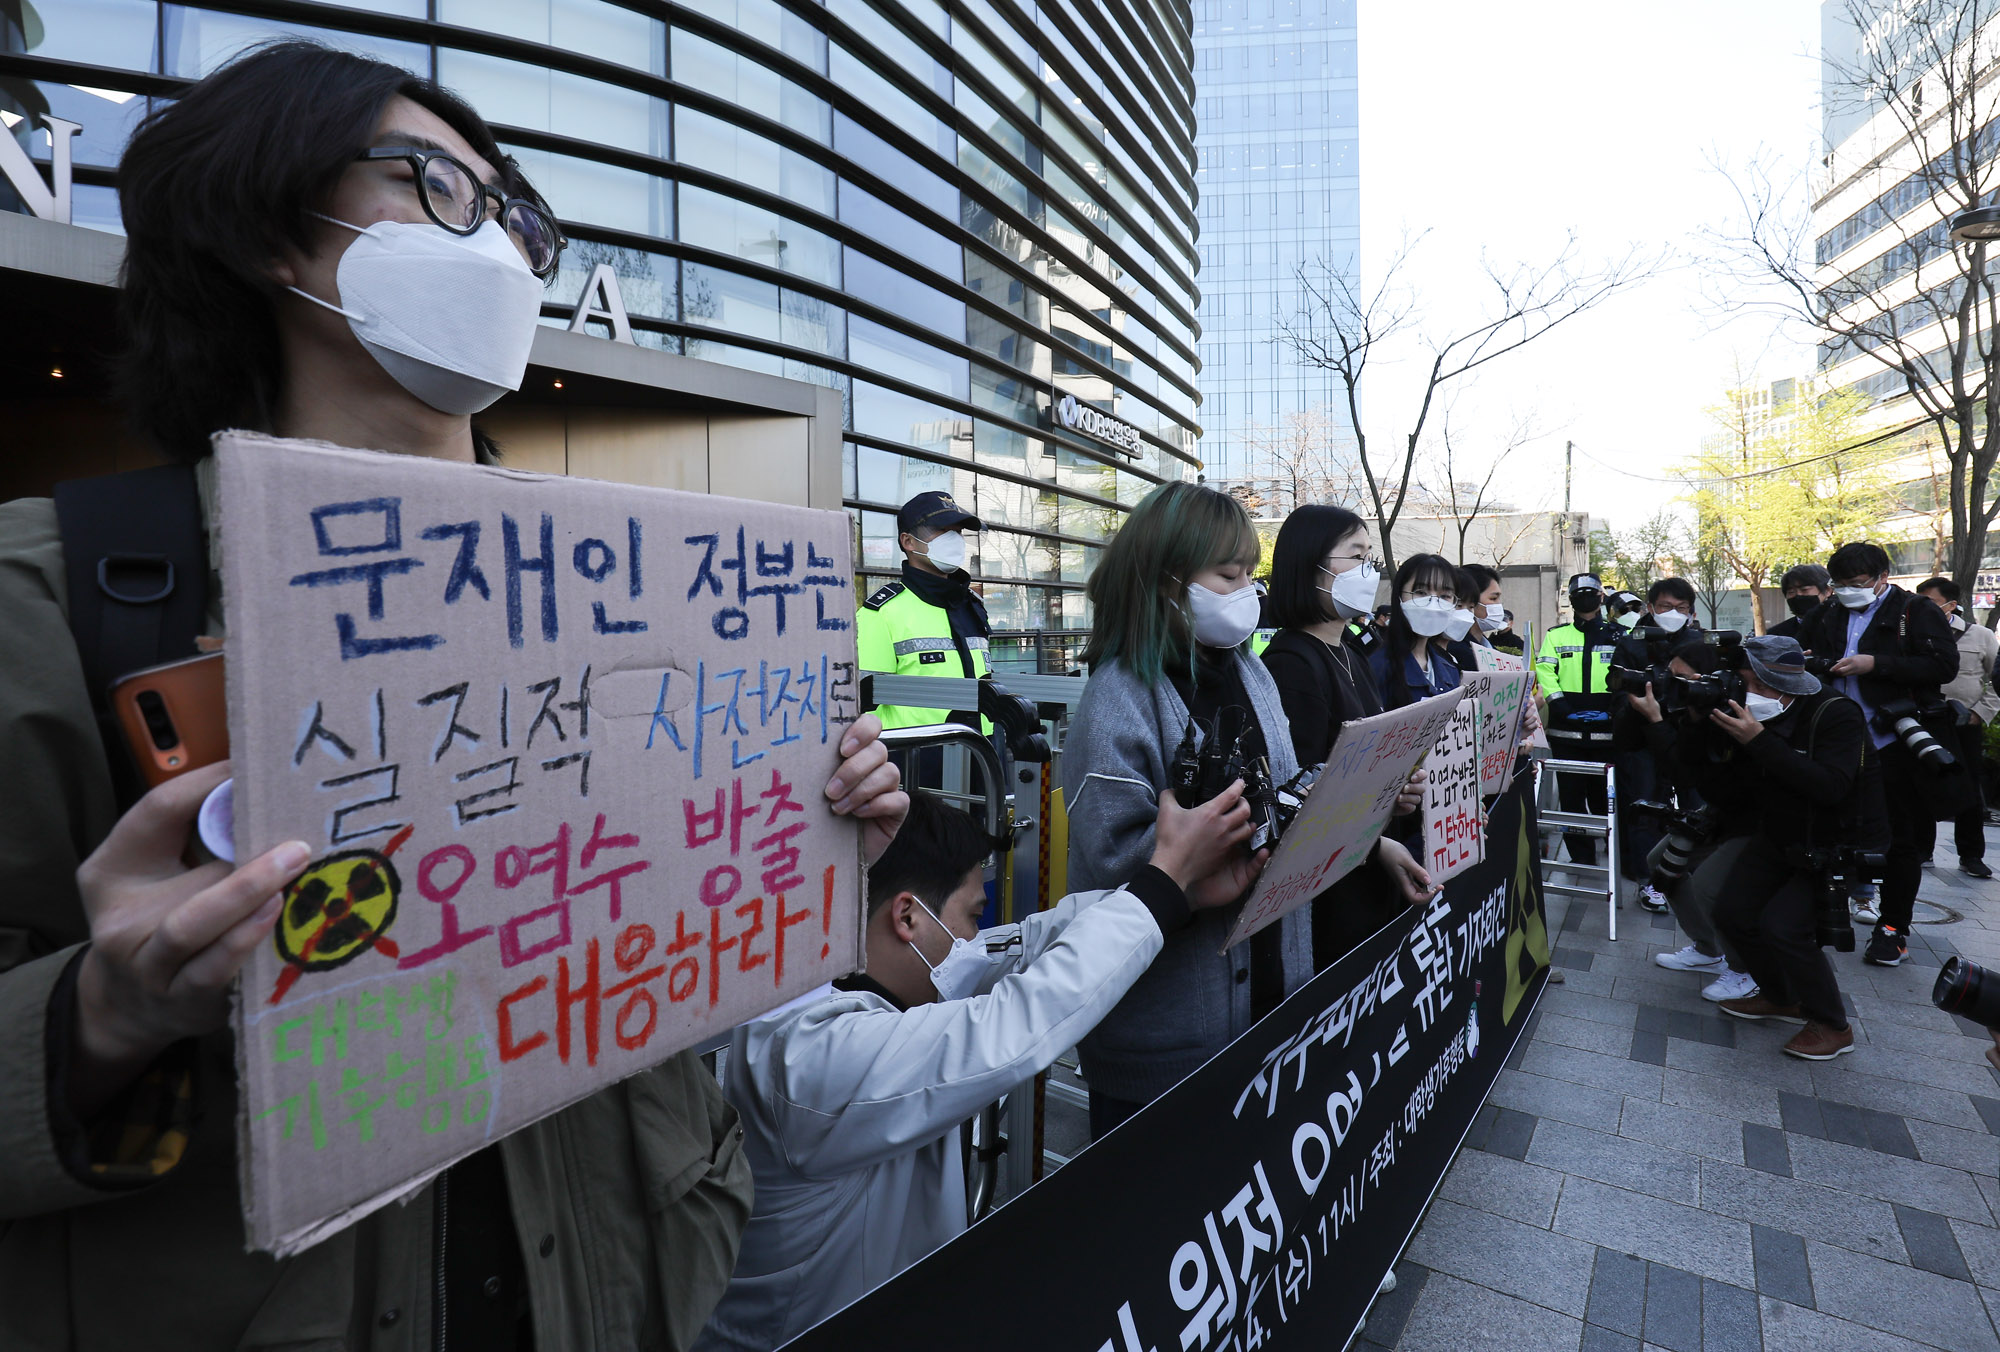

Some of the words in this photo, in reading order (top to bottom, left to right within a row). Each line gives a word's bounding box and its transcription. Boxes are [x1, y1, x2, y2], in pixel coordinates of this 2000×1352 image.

[289, 497, 648, 660] 문재인
[685, 524, 852, 641] 정부는
[1452, 710, 1473, 751] 원전
[1493, 677, 1518, 721] 안전
[294, 665, 592, 844] 실질적
[1330, 729, 1379, 780] 지구
[397, 812, 651, 969] 오염수
[683, 769, 809, 907] 방출
[1433, 804, 1482, 873] 규탄한다
[1244, 845, 1346, 934] 철회하라!
[1457, 882, 1507, 978] 기자회견
[495, 863, 835, 1067] 대응하라!
[273, 970, 459, 1067] 대학생
[1274, 1234, 1311, 1323] (수)
[1318, 1174, 1355, 1257] 11시
[1369, 1121, 1396, 1189] 주최
[1404, 1025, 1465, 1134] 대학생기후행동
